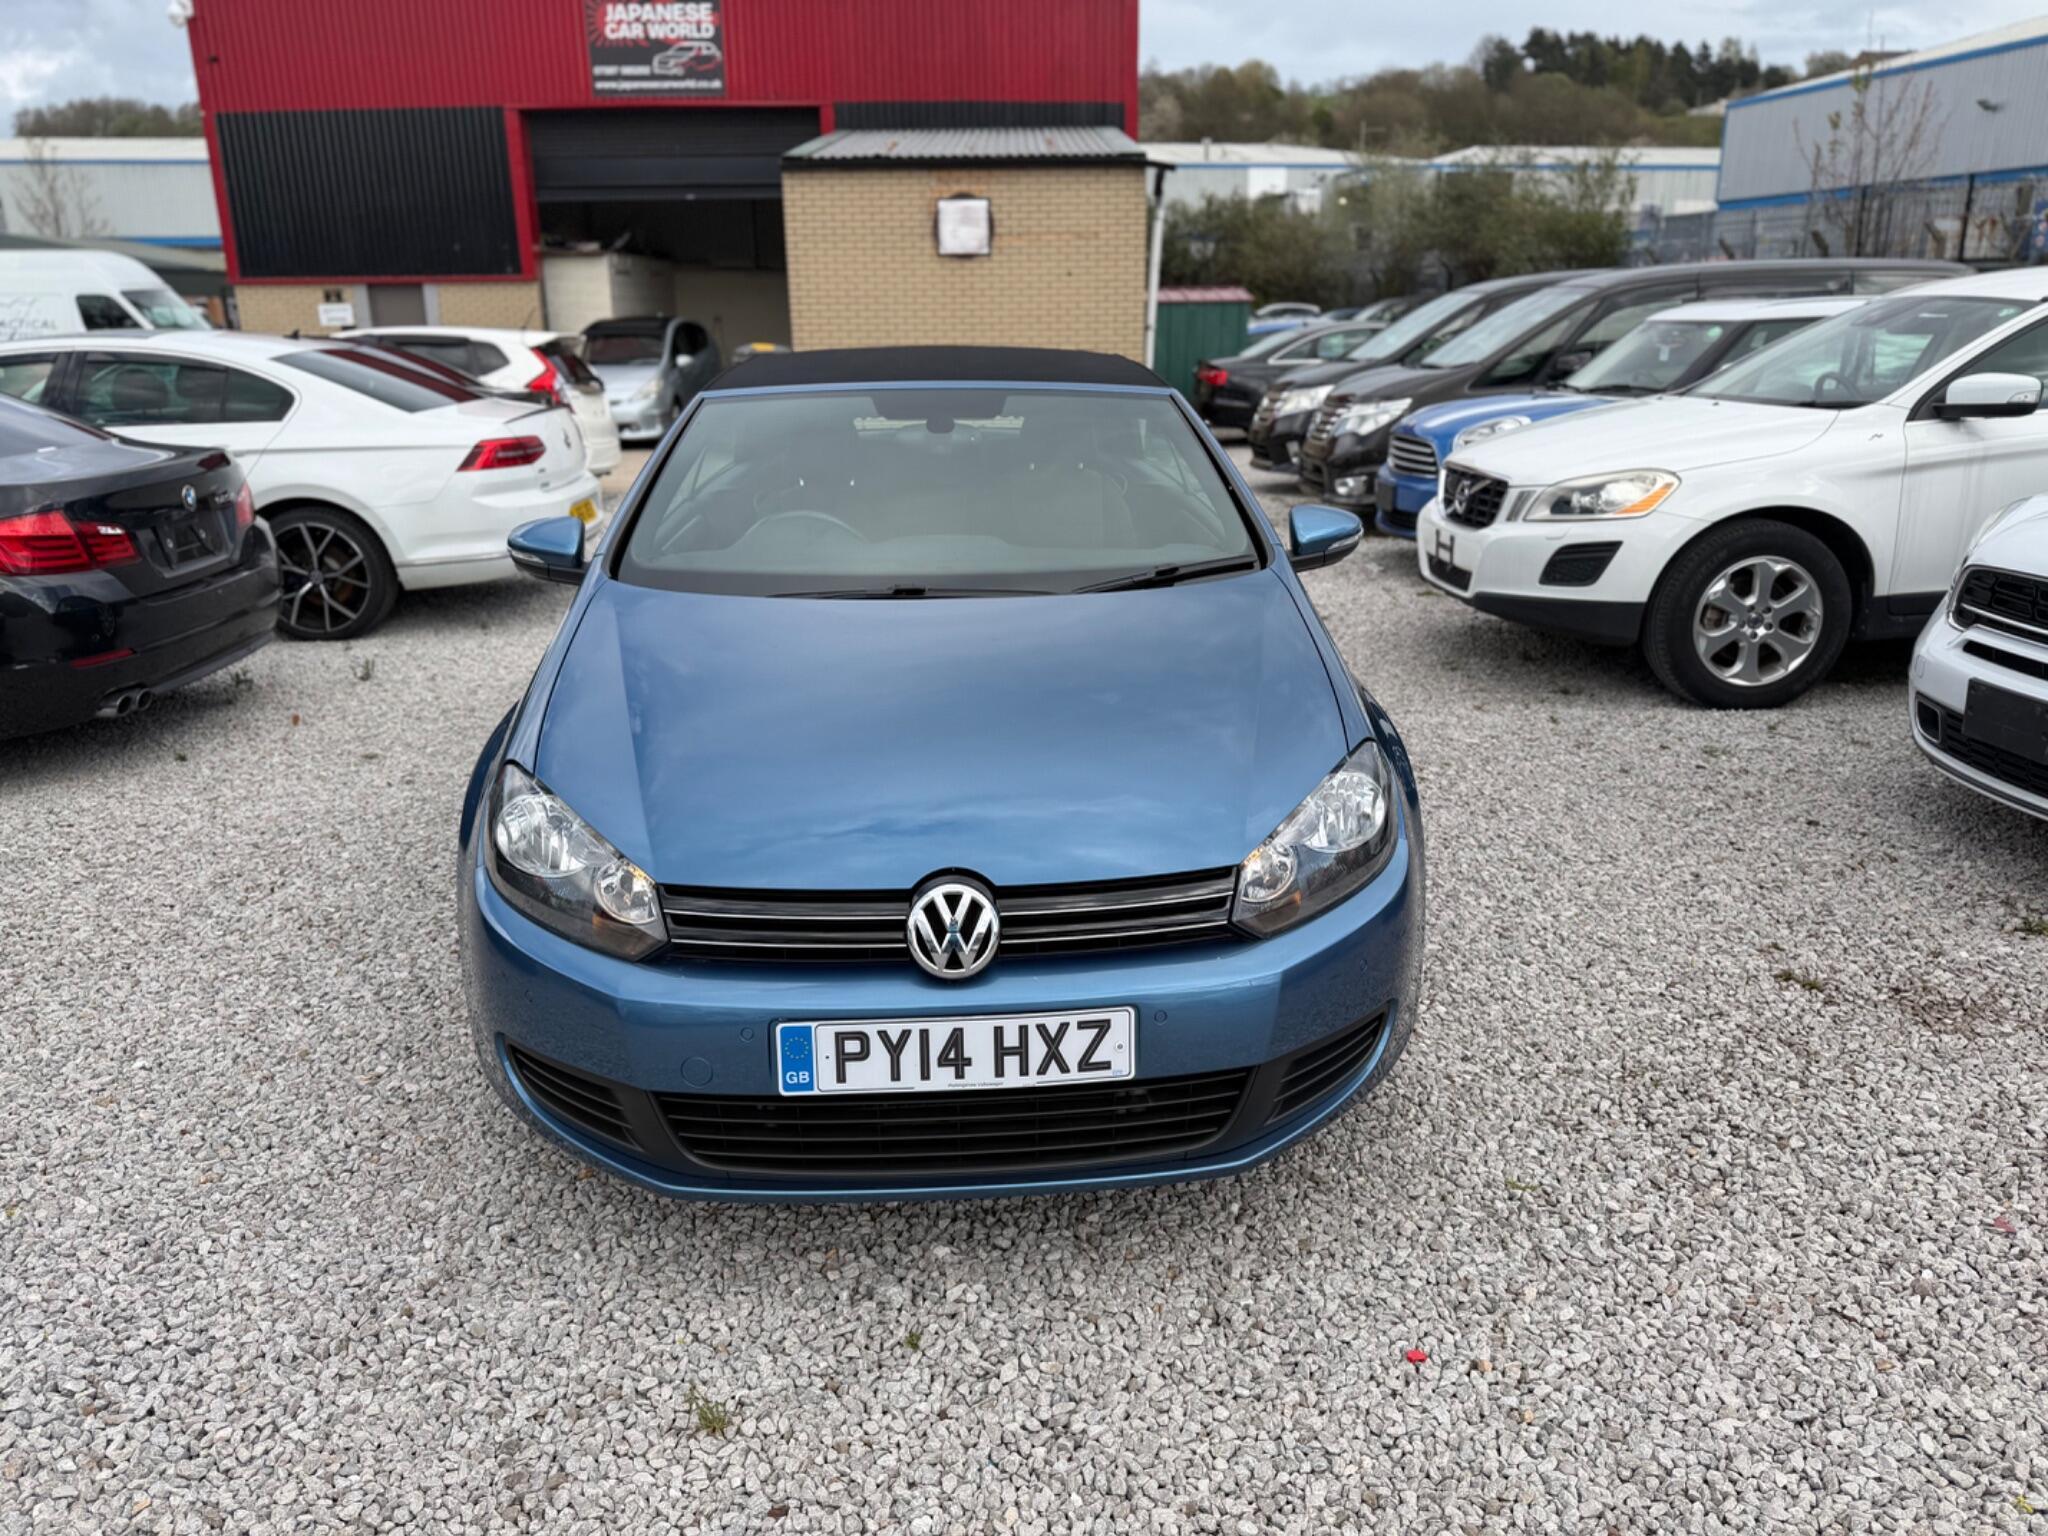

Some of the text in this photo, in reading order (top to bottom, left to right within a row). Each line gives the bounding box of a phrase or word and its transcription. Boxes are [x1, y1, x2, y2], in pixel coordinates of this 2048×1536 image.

[605, 3, 713, 21] JAPANESE
[604, 22, 715, 39] CAR WORLD
[834, 1019, 1112, 1084] PY14 HXZ
[786, 1071, 810, 1085] GB
